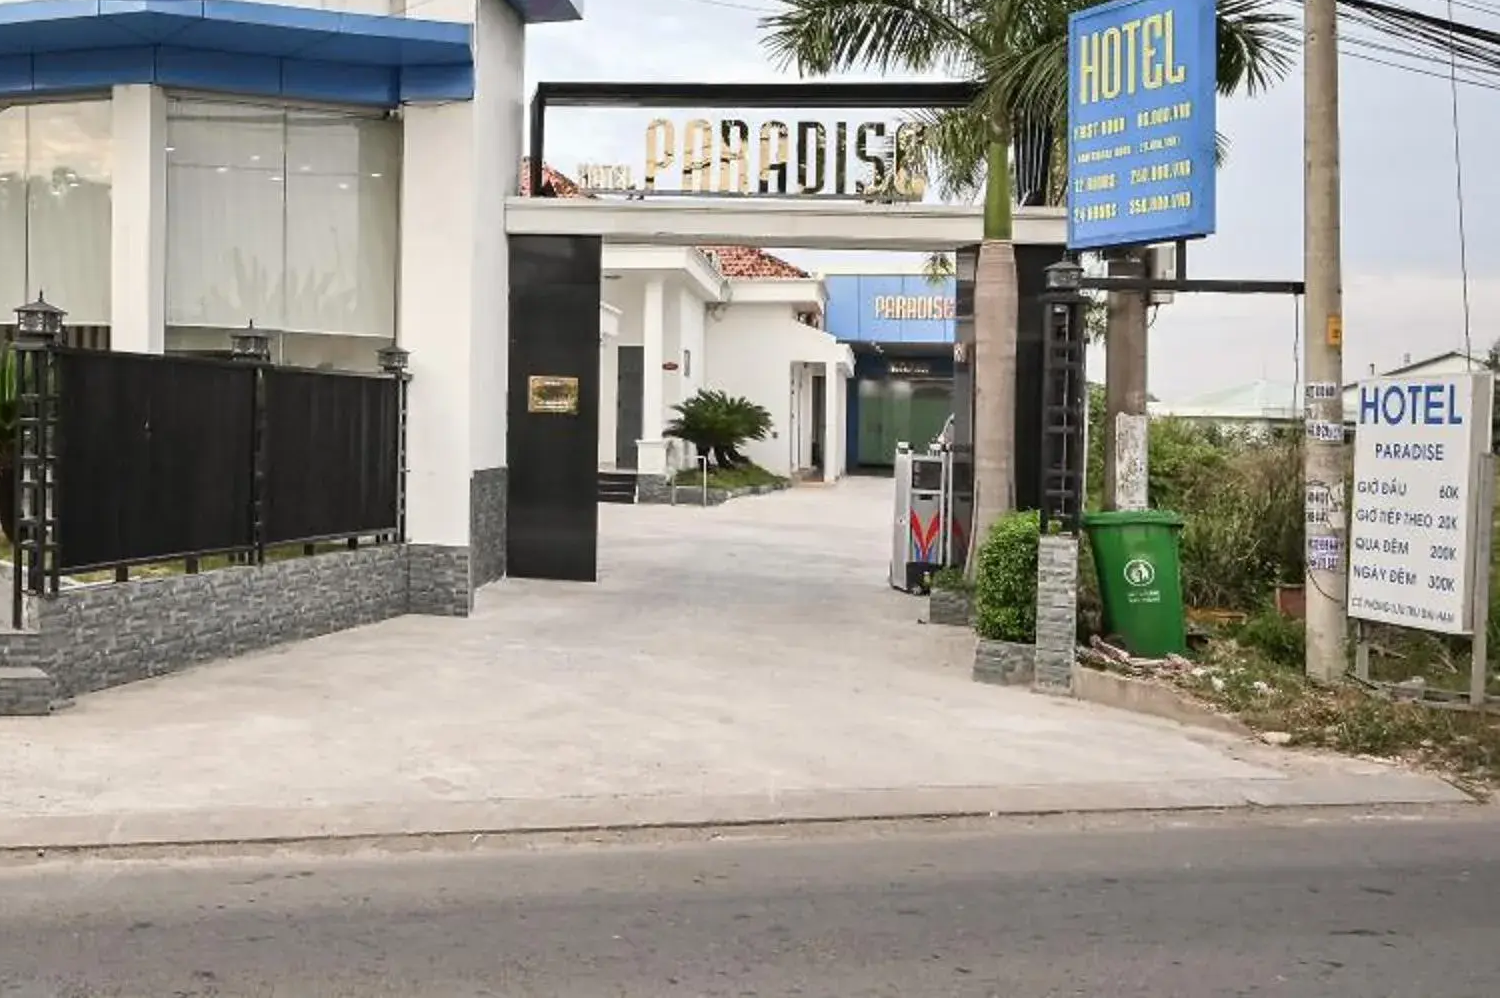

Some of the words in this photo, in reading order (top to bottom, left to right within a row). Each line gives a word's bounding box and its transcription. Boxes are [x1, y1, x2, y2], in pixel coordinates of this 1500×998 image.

[1079, 9, 1186, 105] HOTEL
[875, 295, 956, 319] PARADISE
[1360, 384, 1462, 425] HOTEL
[1375, 443, 1443, 461] PARADISE
